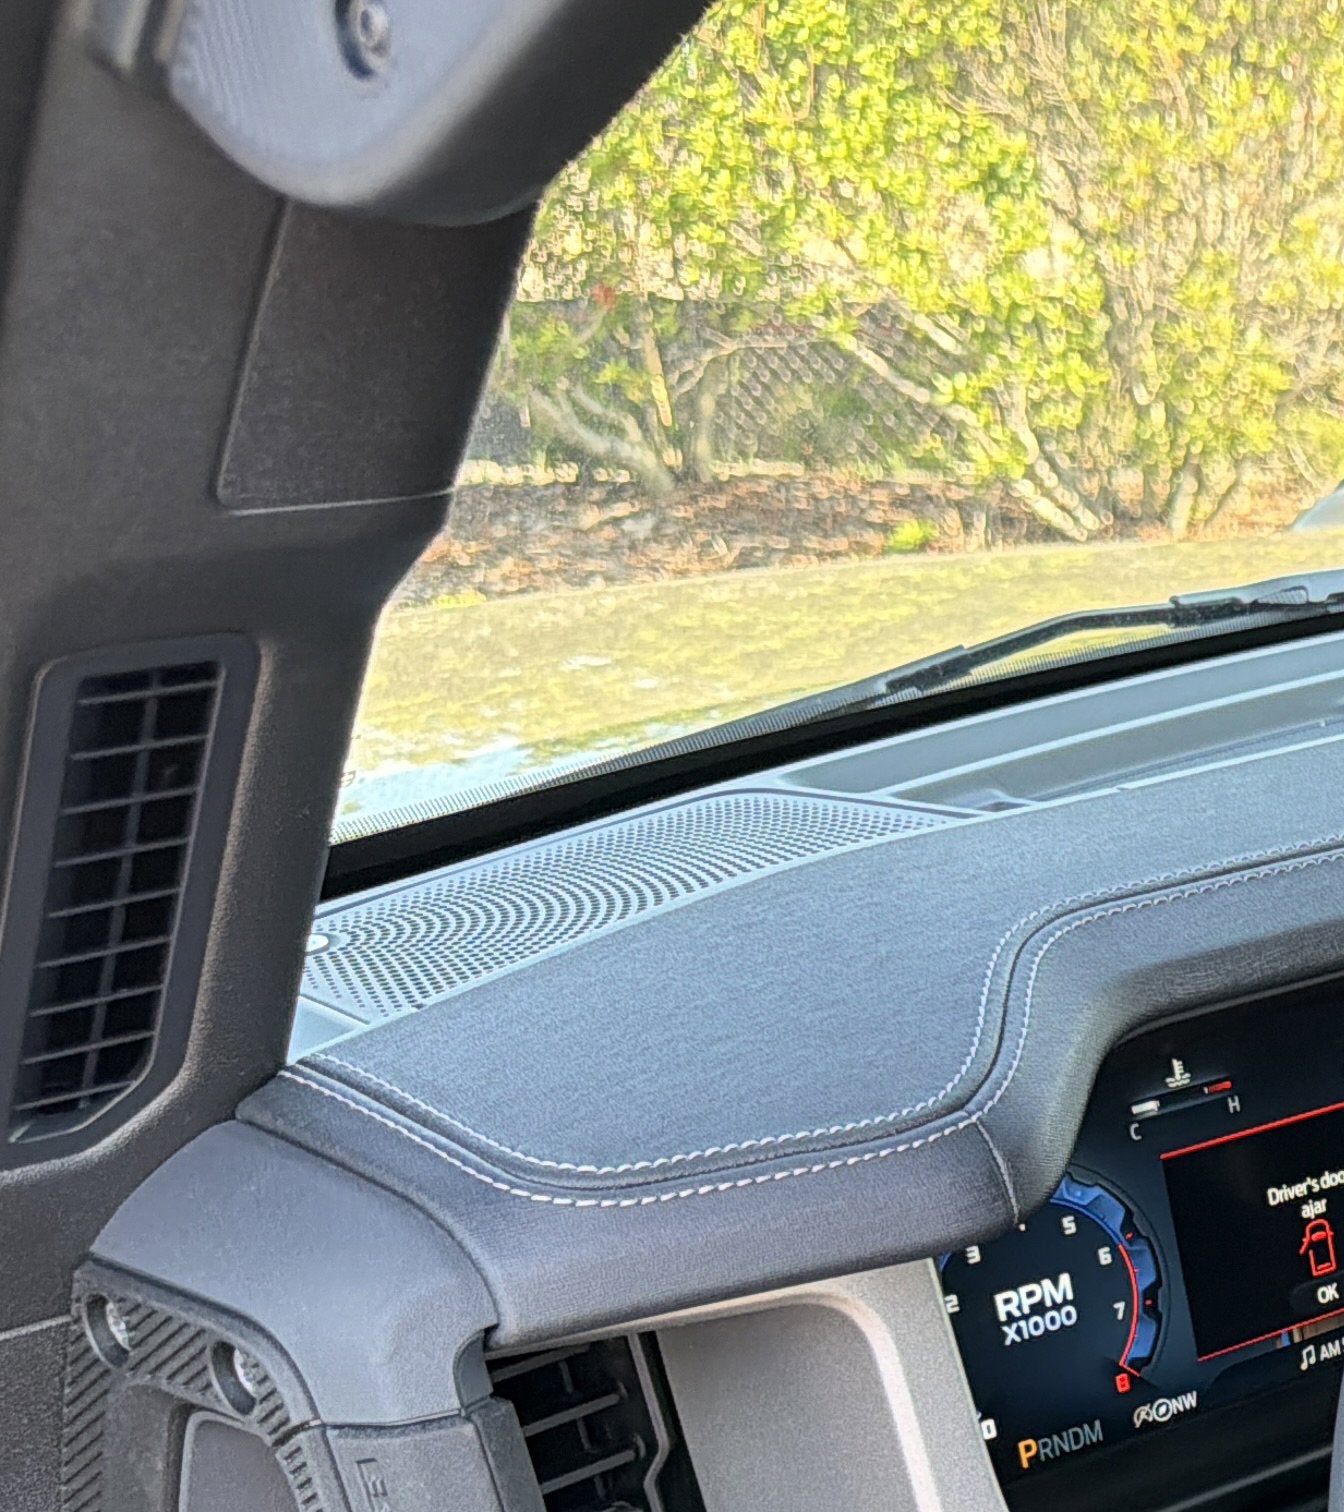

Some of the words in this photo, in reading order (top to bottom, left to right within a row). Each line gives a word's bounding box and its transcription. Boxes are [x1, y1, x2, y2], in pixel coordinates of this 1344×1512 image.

[1227, 1095, 1241, 1114] H
[1129, 1123, 1142, 1141] C
[1267, 1177, 1320, 1206] Driver's
[1301, 1199, 1328, 1220] ajar
[1062, 1215, 1077, 1235] 5
[966, 1245, 981, 1264] 3
[1098, 1247, 1112, 1265] 6
[993, 1272, 1074, 1322] RPM
[1317, 1283, 1340, 1304] OK
[1113, 1301, 1126, 1320] 7
[1319, 1341, 1341, 1362] AM
[1115, 1373, 1131, 1393] 8
[1171, 1391, 1198, 1414] NW
